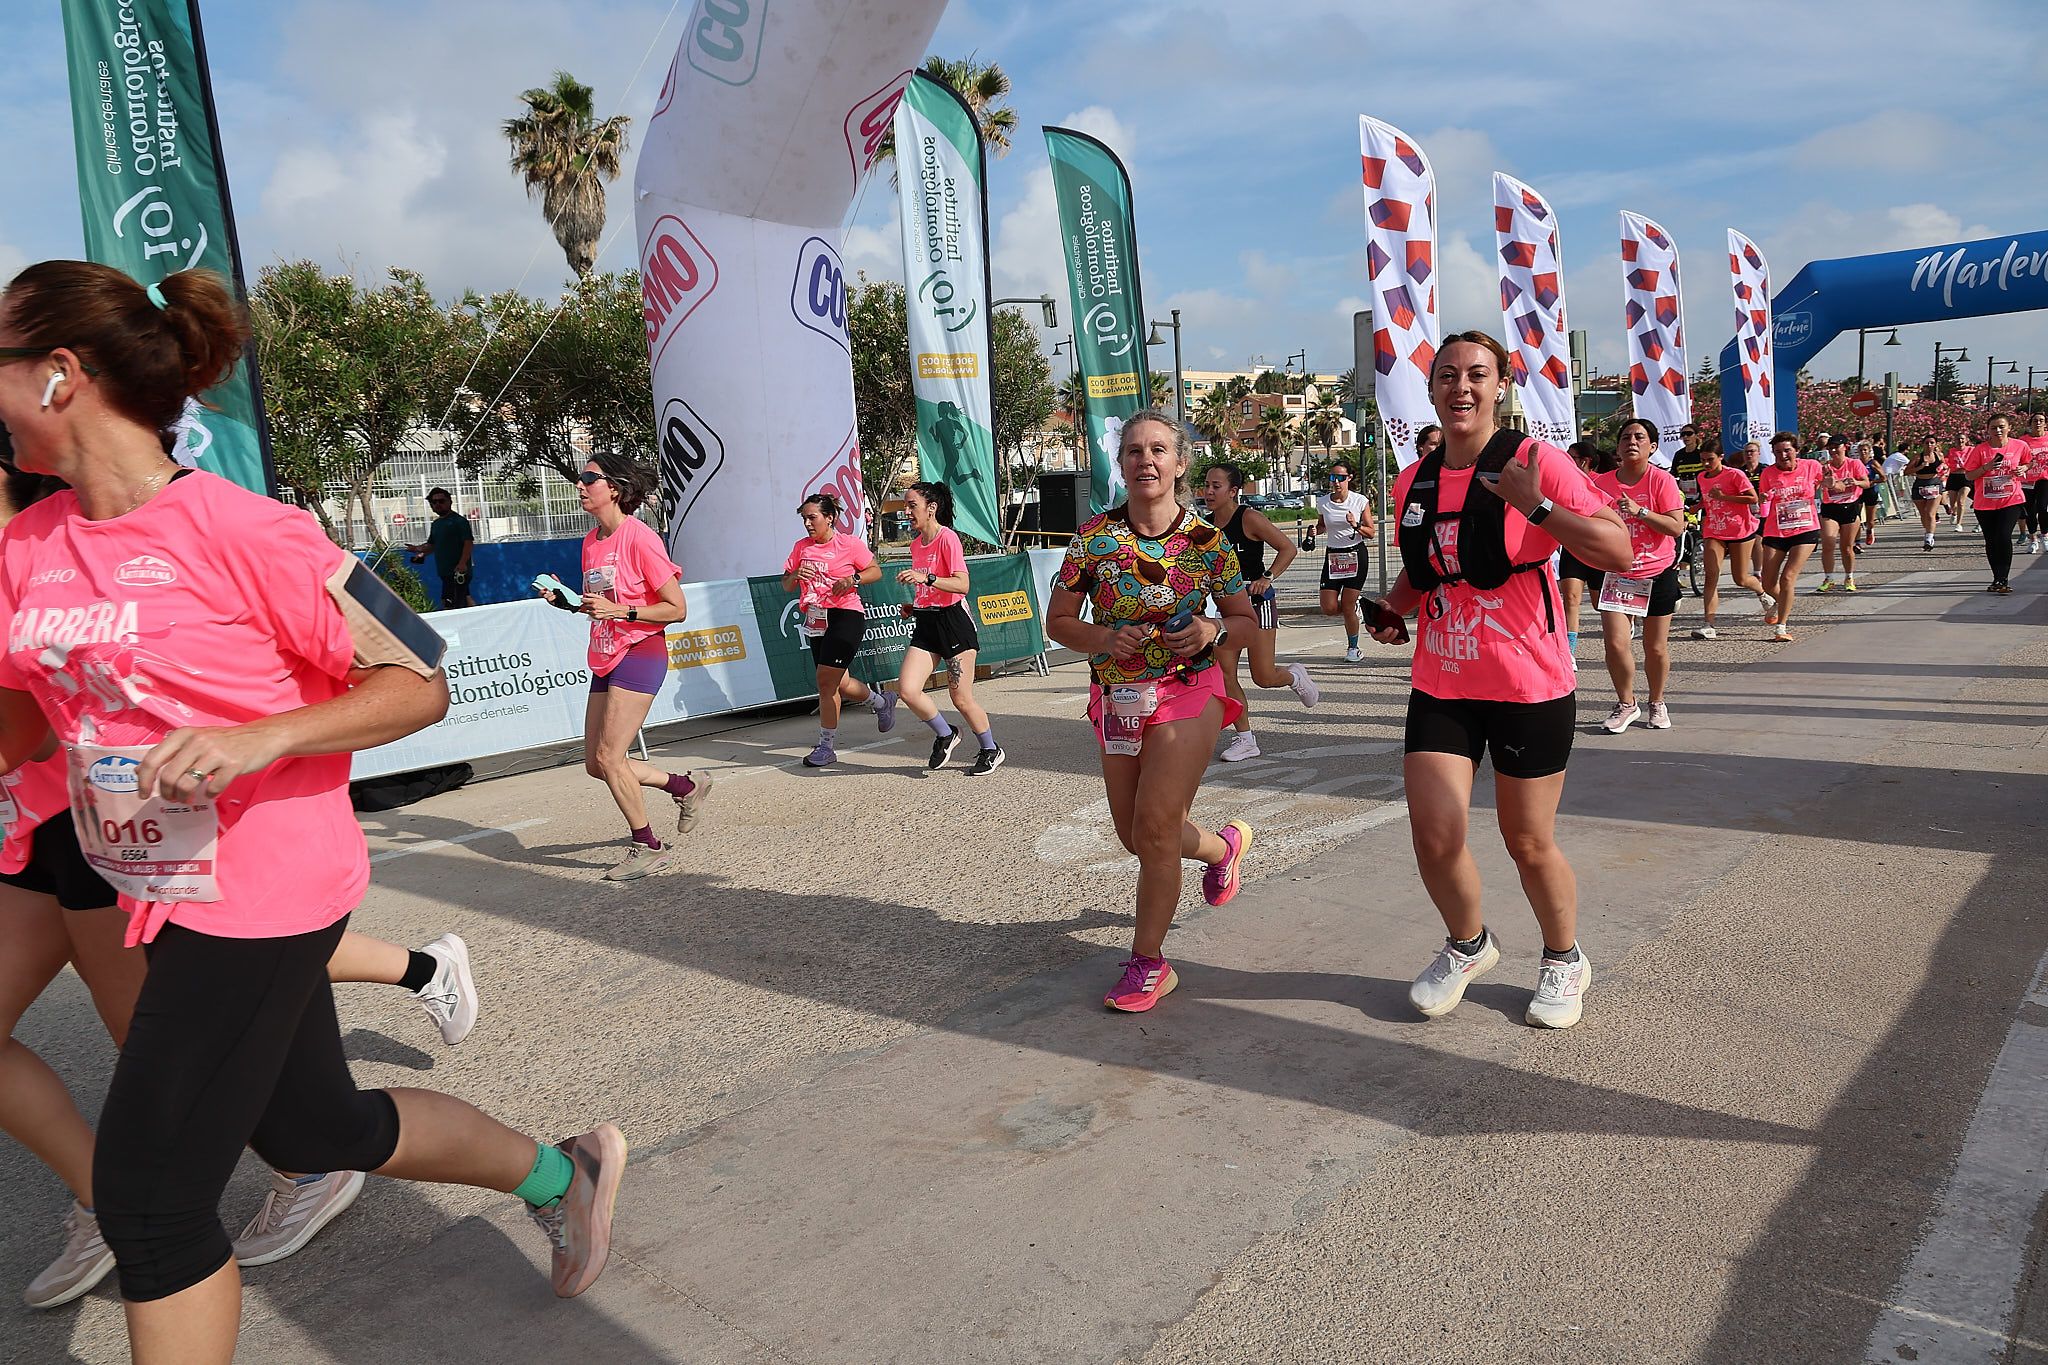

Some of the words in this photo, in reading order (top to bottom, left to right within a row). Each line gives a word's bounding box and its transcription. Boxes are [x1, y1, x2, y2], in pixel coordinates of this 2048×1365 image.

[981, 600, 998, 609] 900
[998, 598, 1011, 608] 131
[1011, 595, 1026, 605] 002
[1616, 591, 1634, 600] 016
[863, 602, 902, 620] itutos
[984, 607, 1028, 619] www.ioa.es
[1447, 603, 1466, 634] LA
[9, 601, 139, 654] CARRERA
[666, 637, 691, 652] 900
[692, 634, 712, 648] 131
[713, 631, 738, 645] 002
[876, 643, 906, 655] dentales
[1424, 628, 1480, 660] MUJER
[668, 645, 740, 665] www.ioa.es
[445, 651, 532, 680] stitutos
[1440, 659, 1460, 674] 2026
[449, 668, 588, 706] dontológicos
[480, 703, 530, 721] dentales
[103, 819, 163, 844] 016
[121, 850, 149, 861] 6564
